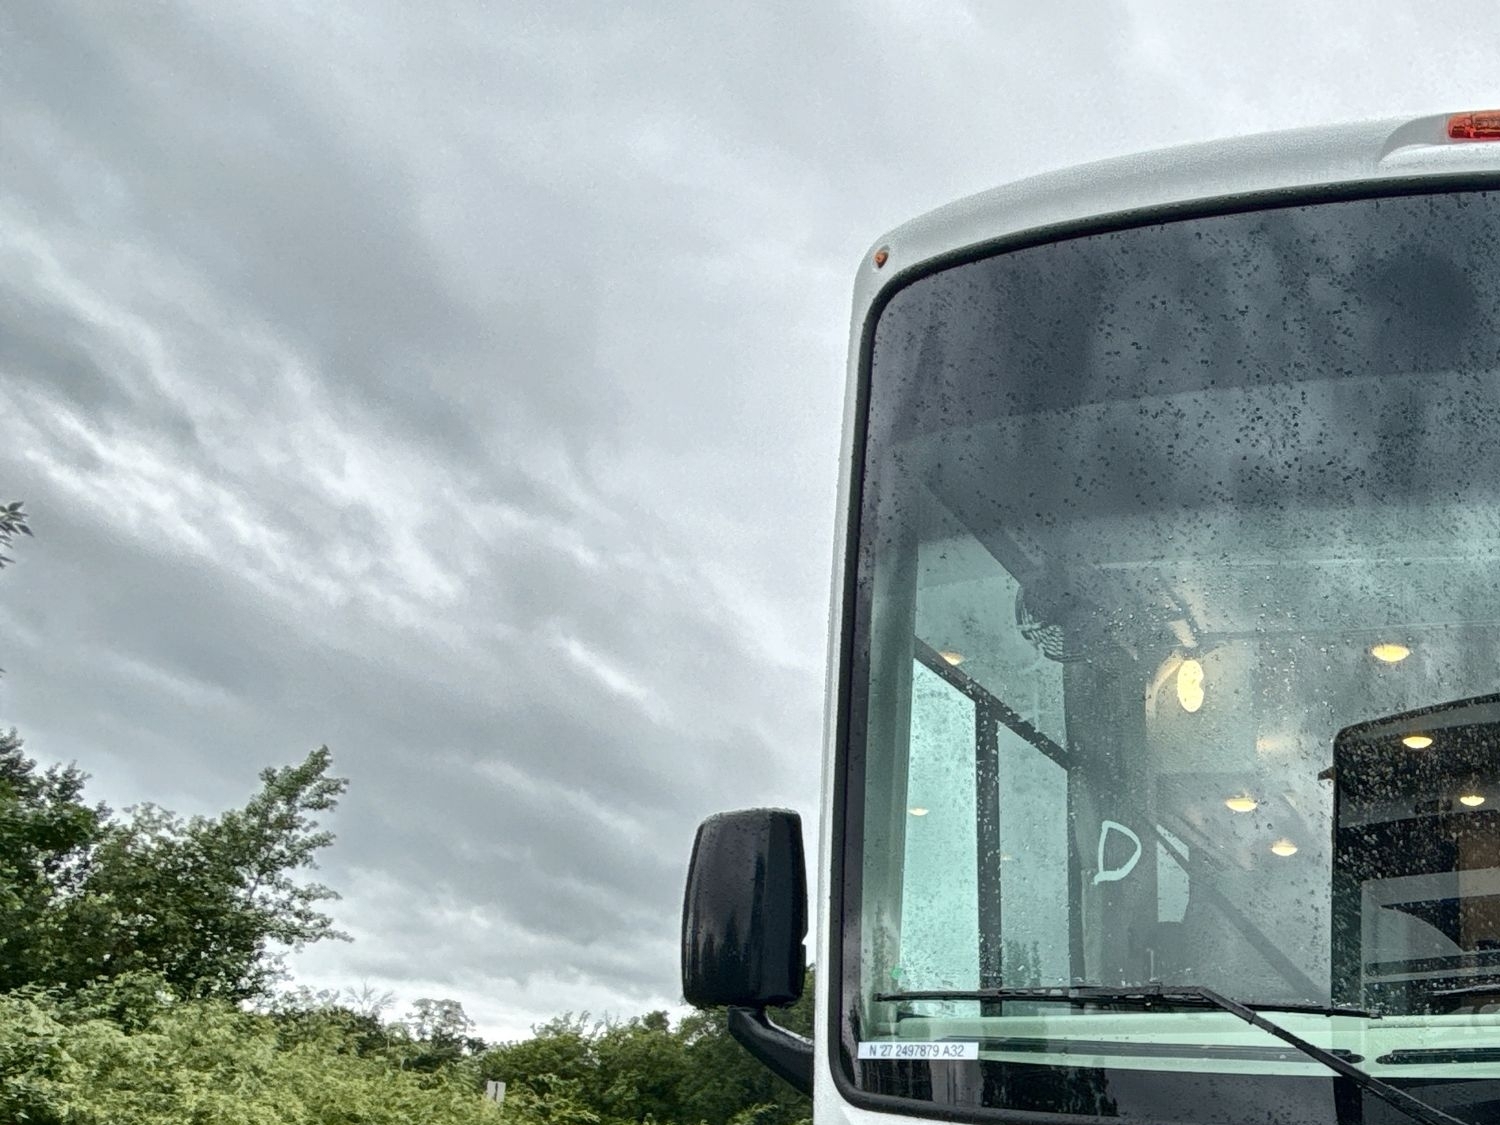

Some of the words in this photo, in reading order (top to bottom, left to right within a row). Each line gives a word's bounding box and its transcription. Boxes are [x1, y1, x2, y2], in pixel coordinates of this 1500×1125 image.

[869, 1044, 877, 1057] N
[896, 1044, 940, 1057] 2497879
[942, 1044, 965, 1057] A32
